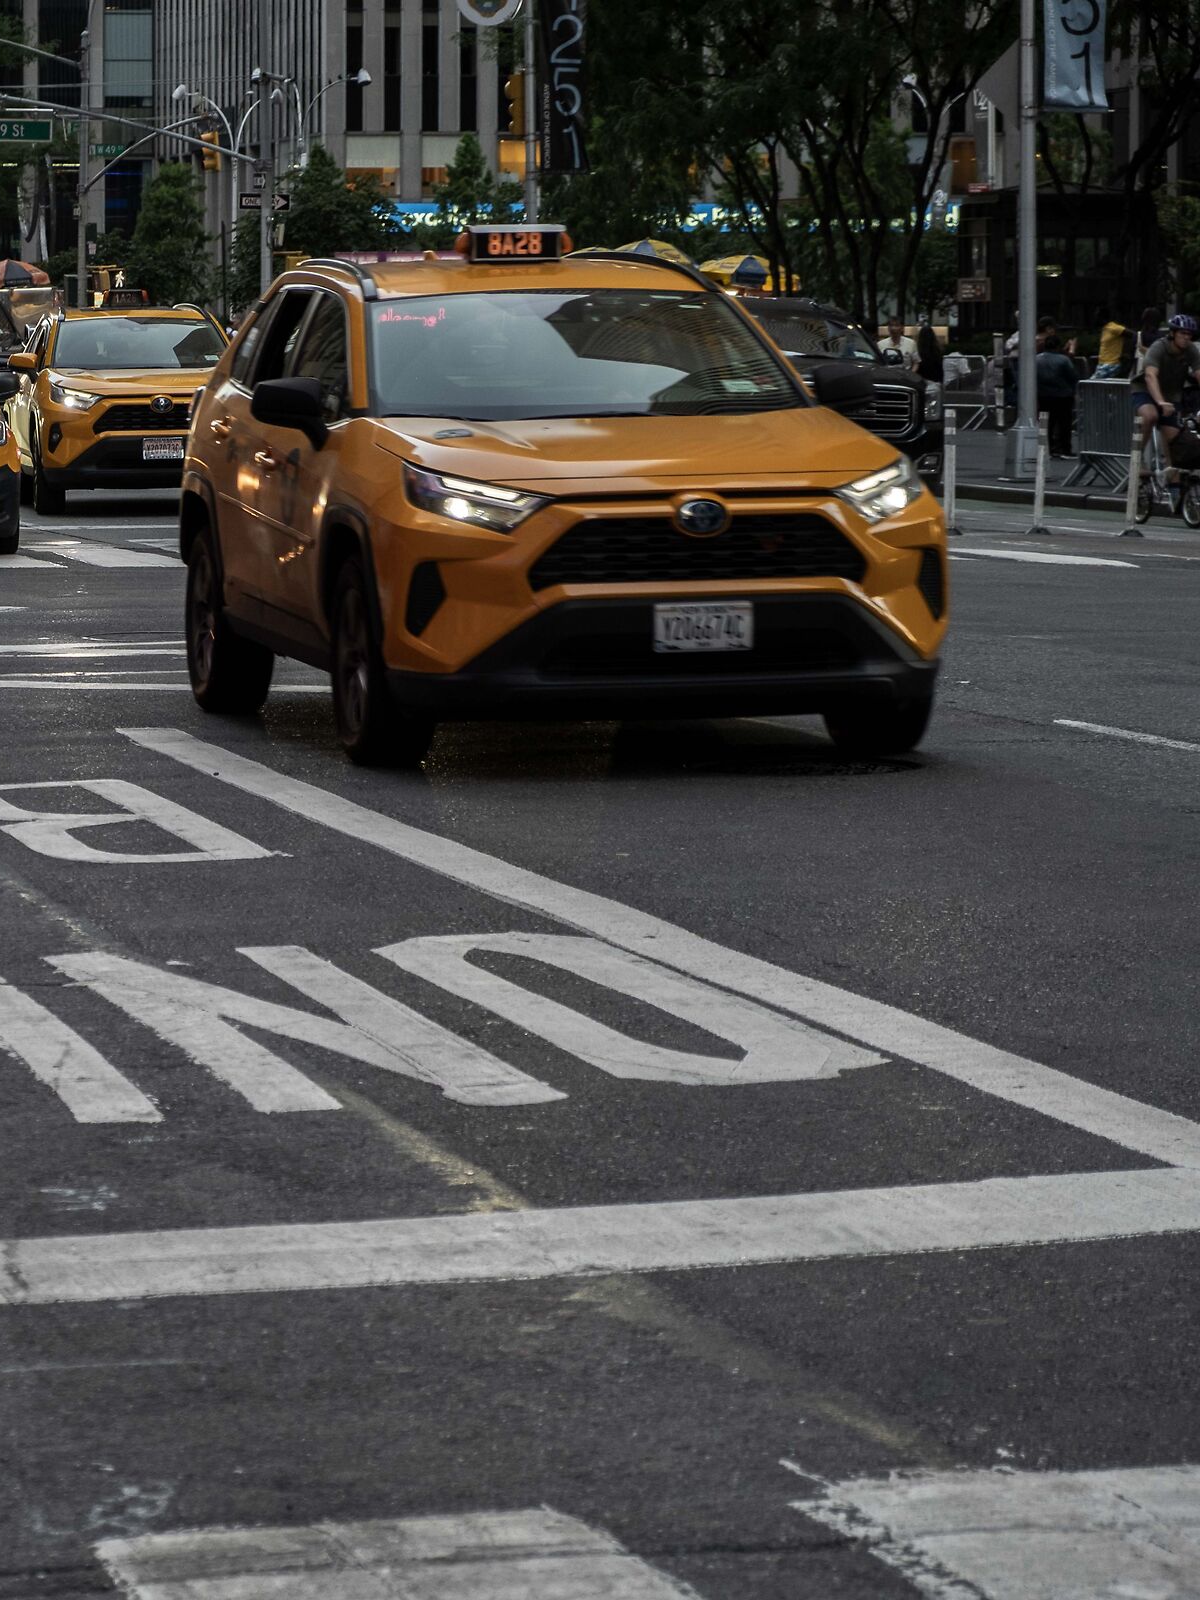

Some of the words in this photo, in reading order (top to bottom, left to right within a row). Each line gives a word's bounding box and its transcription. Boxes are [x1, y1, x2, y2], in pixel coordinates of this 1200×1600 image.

[551, 0, 583, 169] 251
[12, 122, 24, 136] St
[105, 145, 116, 154] 49
[487, 232, 542, 255] 8A28
